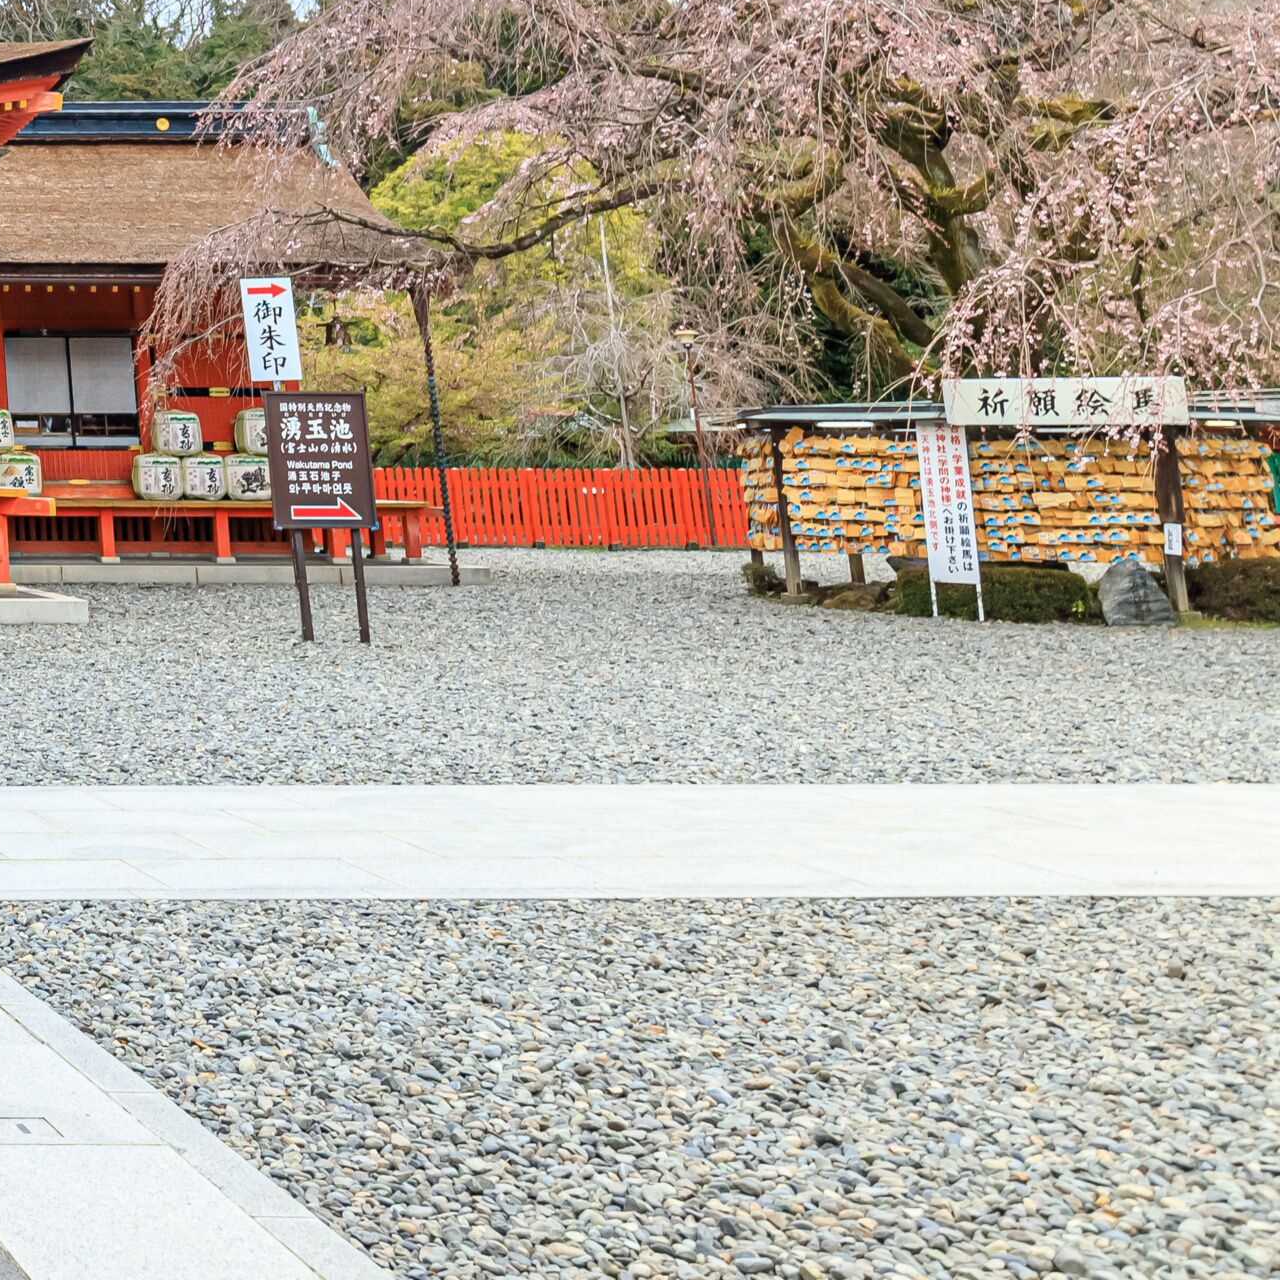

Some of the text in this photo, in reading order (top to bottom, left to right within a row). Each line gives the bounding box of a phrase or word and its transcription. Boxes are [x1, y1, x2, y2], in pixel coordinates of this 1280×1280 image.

[253, 299, 286, 376] 御朱印
[279, 402, 351, 412] 国特別天然記念物
[977, 388, 1160, 417] 祈願絵馬
[280, 416, 353, 440] 湧玉池
[287, 460, 353, 469] Wakutama Pond
